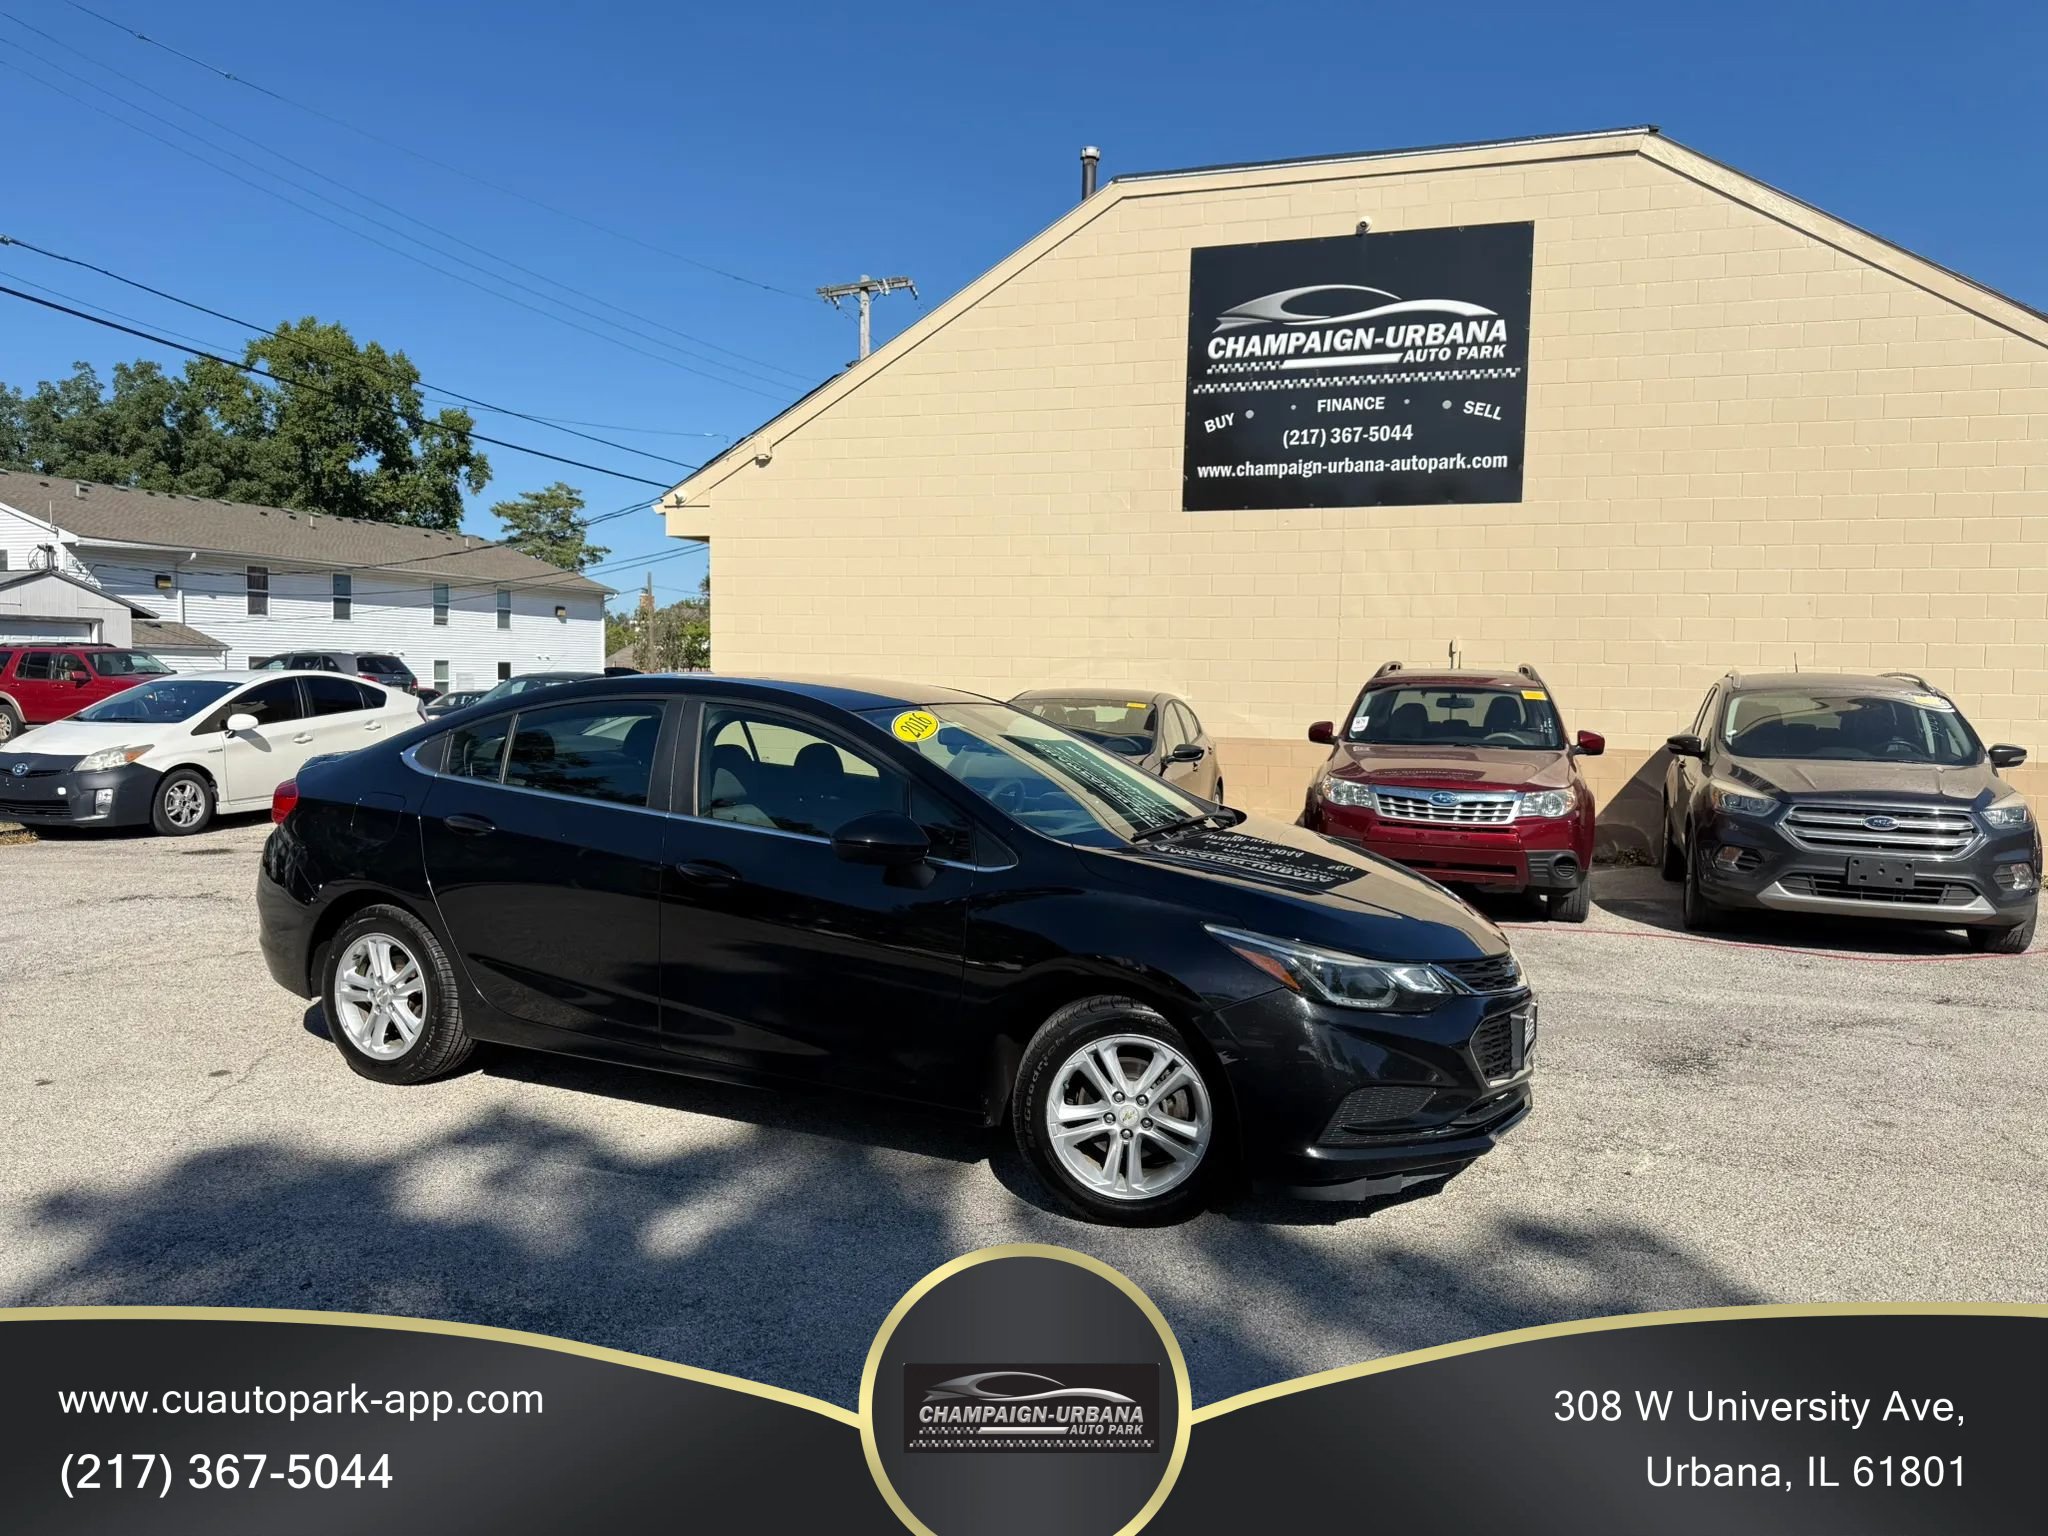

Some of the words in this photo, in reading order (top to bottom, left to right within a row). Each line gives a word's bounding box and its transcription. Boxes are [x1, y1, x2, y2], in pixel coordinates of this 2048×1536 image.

[1207, 319, 1507, 359] CHAMPAIGN-URBANA
[1402, 347, 1451, 363] AUTO
[1456, 344, 1507, 360] PARK
[1204, 412, 1235, 433] BUY
[1317, 396, 1386, 412] FINANCE
[1463, 400, 1502, 420] SELL
[1282, 428, 1326, 449] (217)
[1330, 424, 1414, 444] 367-5044
[1197, 453, 1508, 479] www.champaign-urbana-autopark.com
[900, 712, 933, 738] 2016
